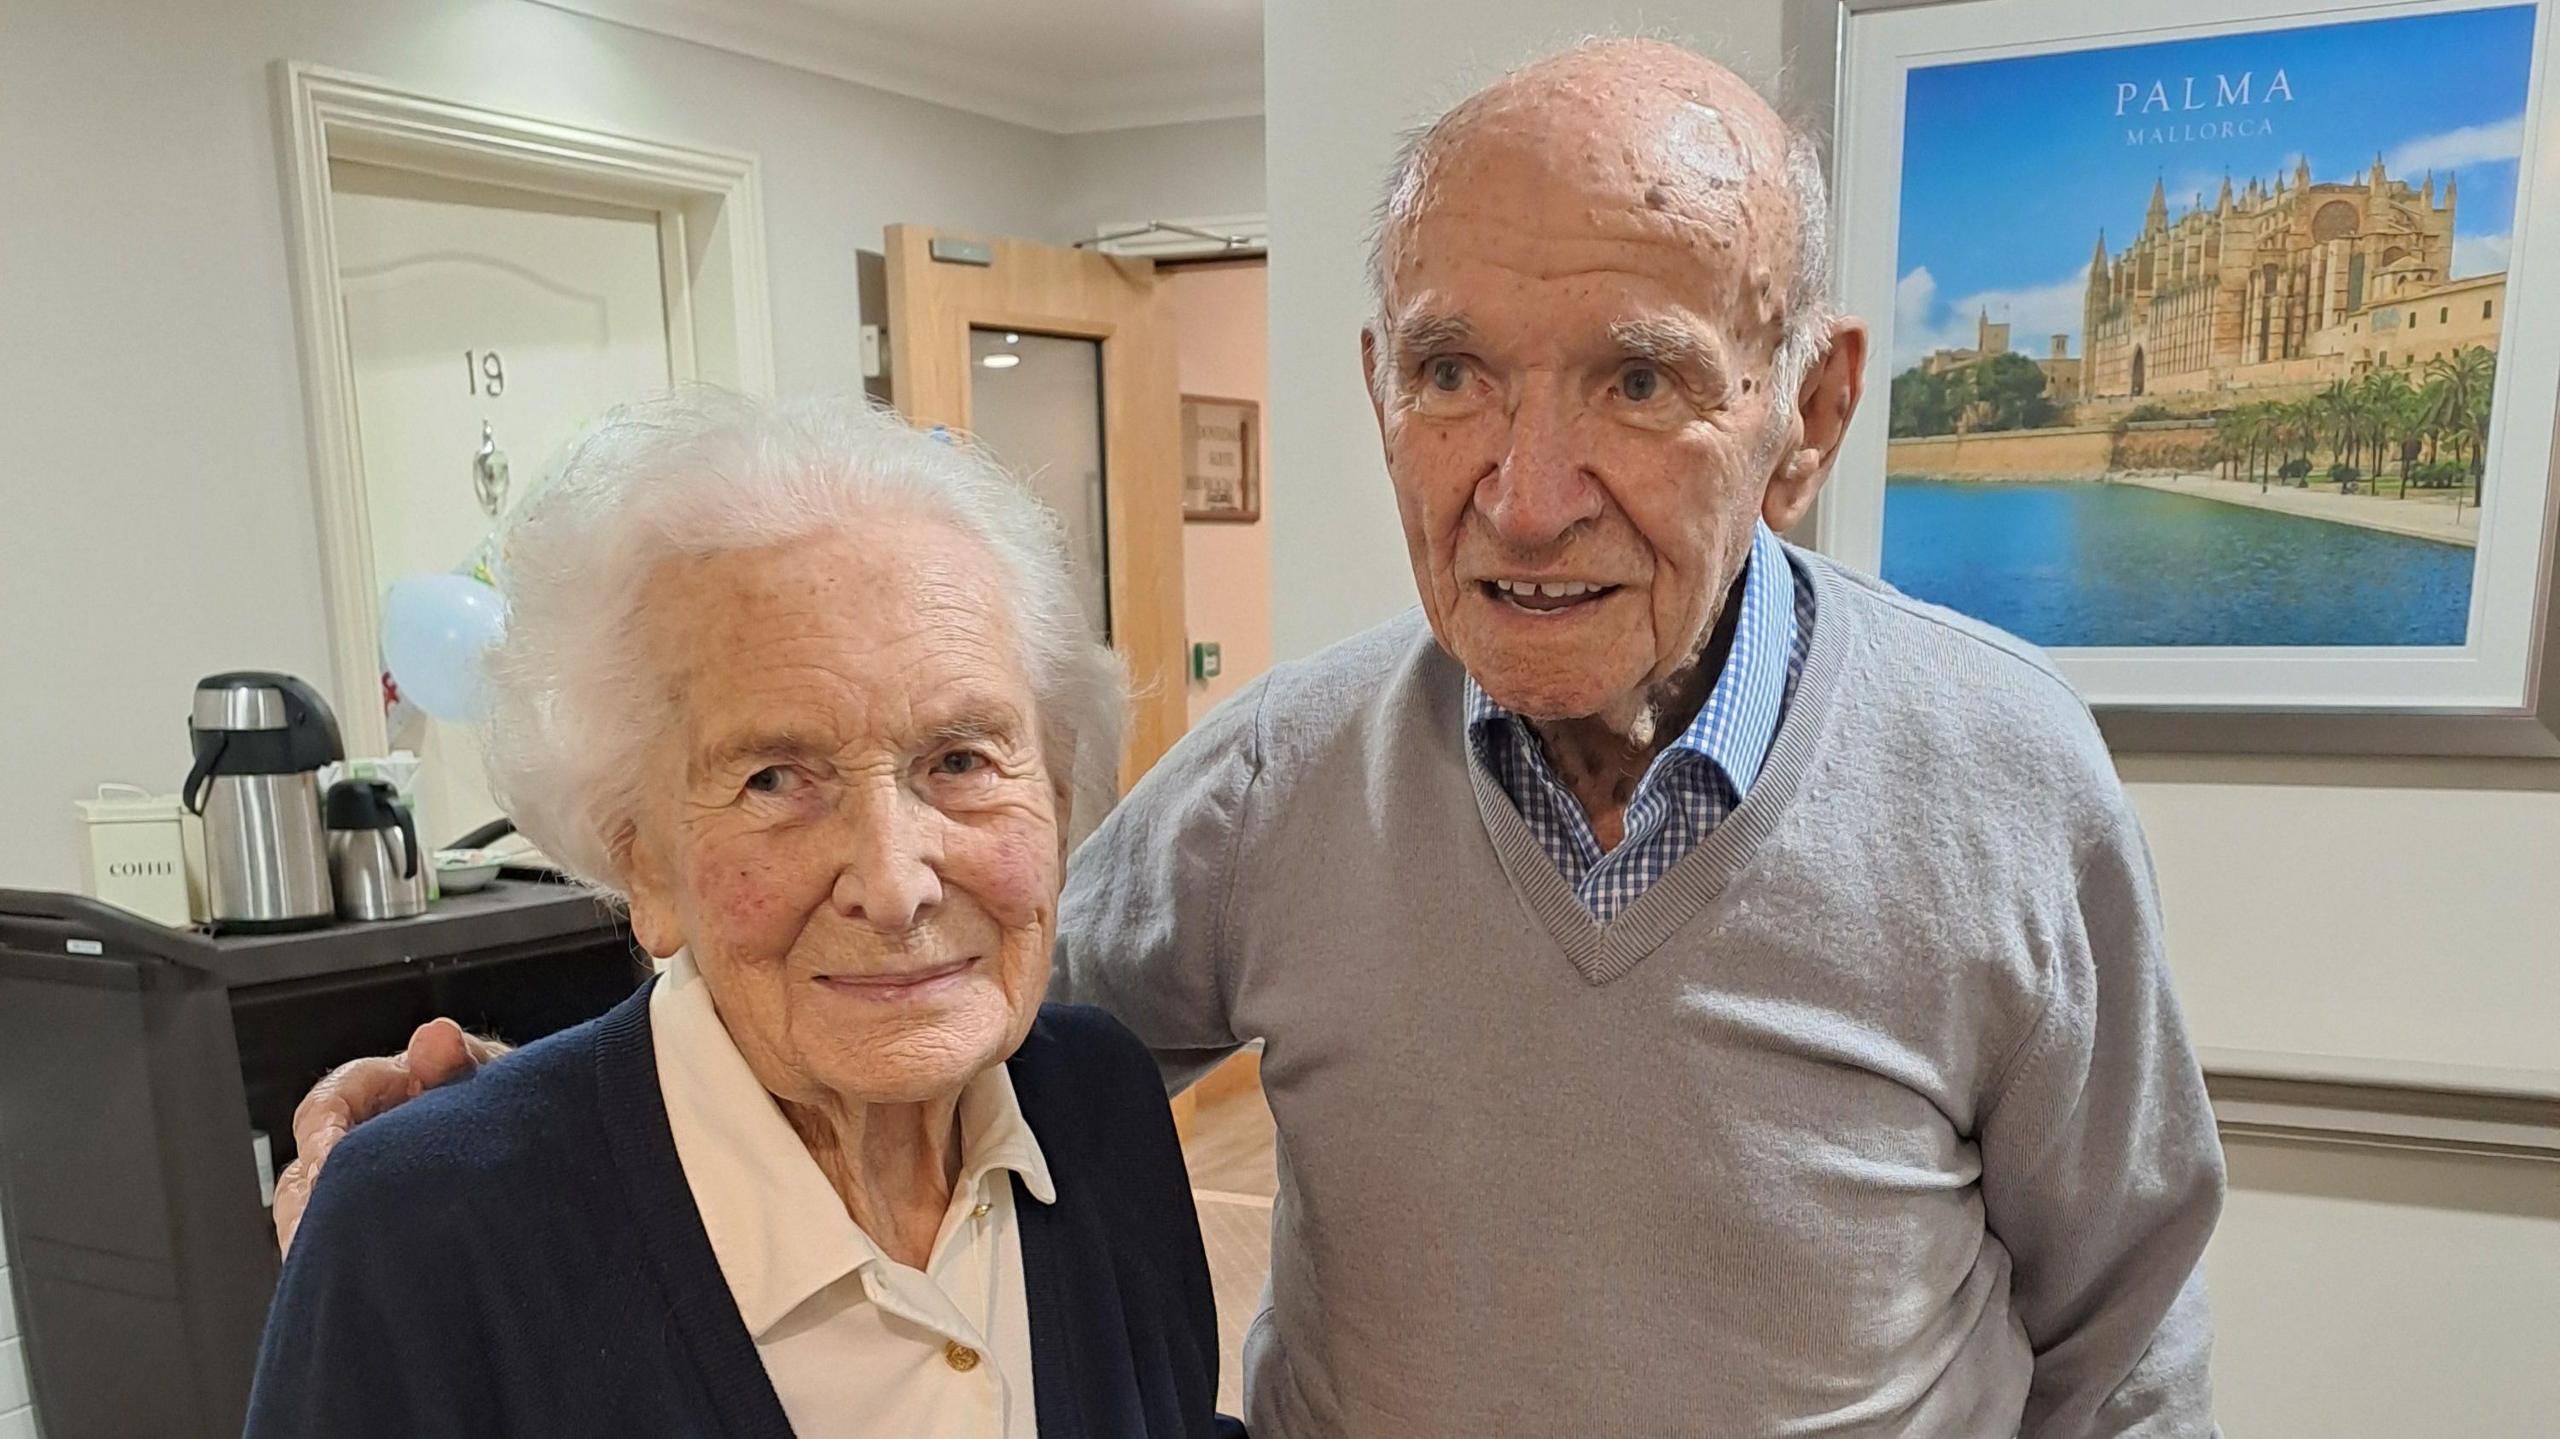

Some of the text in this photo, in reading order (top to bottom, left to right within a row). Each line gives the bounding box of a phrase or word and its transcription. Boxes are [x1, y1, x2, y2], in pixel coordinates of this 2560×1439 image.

[2115, 68, 2295, 116] PALMA
[2126, 118, 2273, 146] MALLORCA
[465, 350, 504, 397] 19
